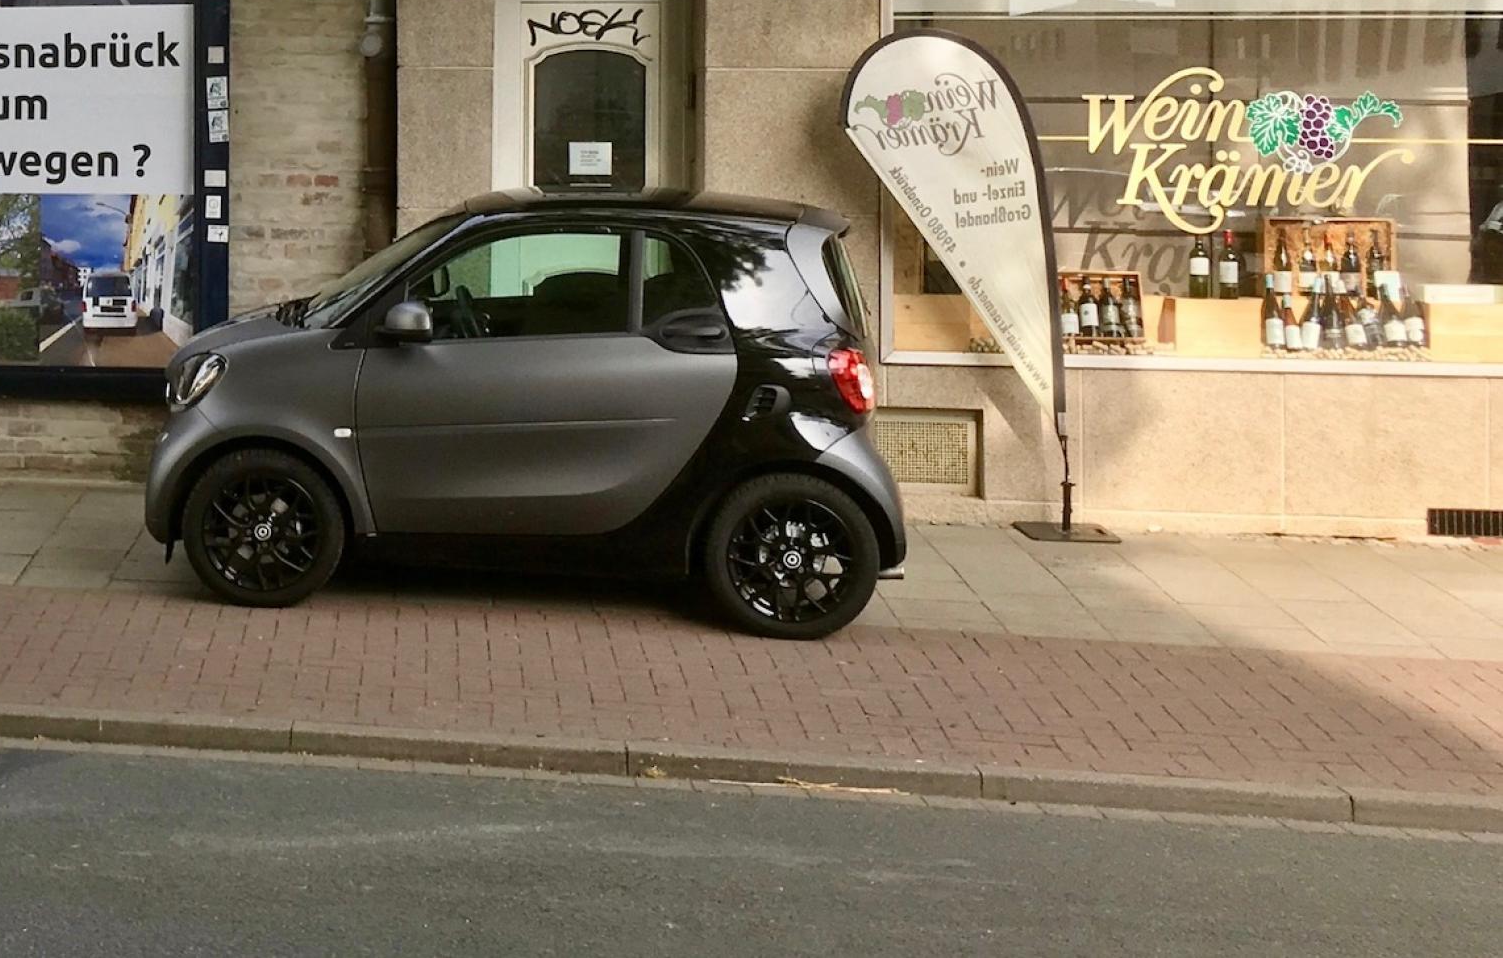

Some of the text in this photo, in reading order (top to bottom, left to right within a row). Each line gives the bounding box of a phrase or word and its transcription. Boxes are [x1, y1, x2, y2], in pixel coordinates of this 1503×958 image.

[1081, 66, 1251, 155] Wein
[133, 144, 151, 177] ?
[1116, 143, 1415, 234] Krämer
